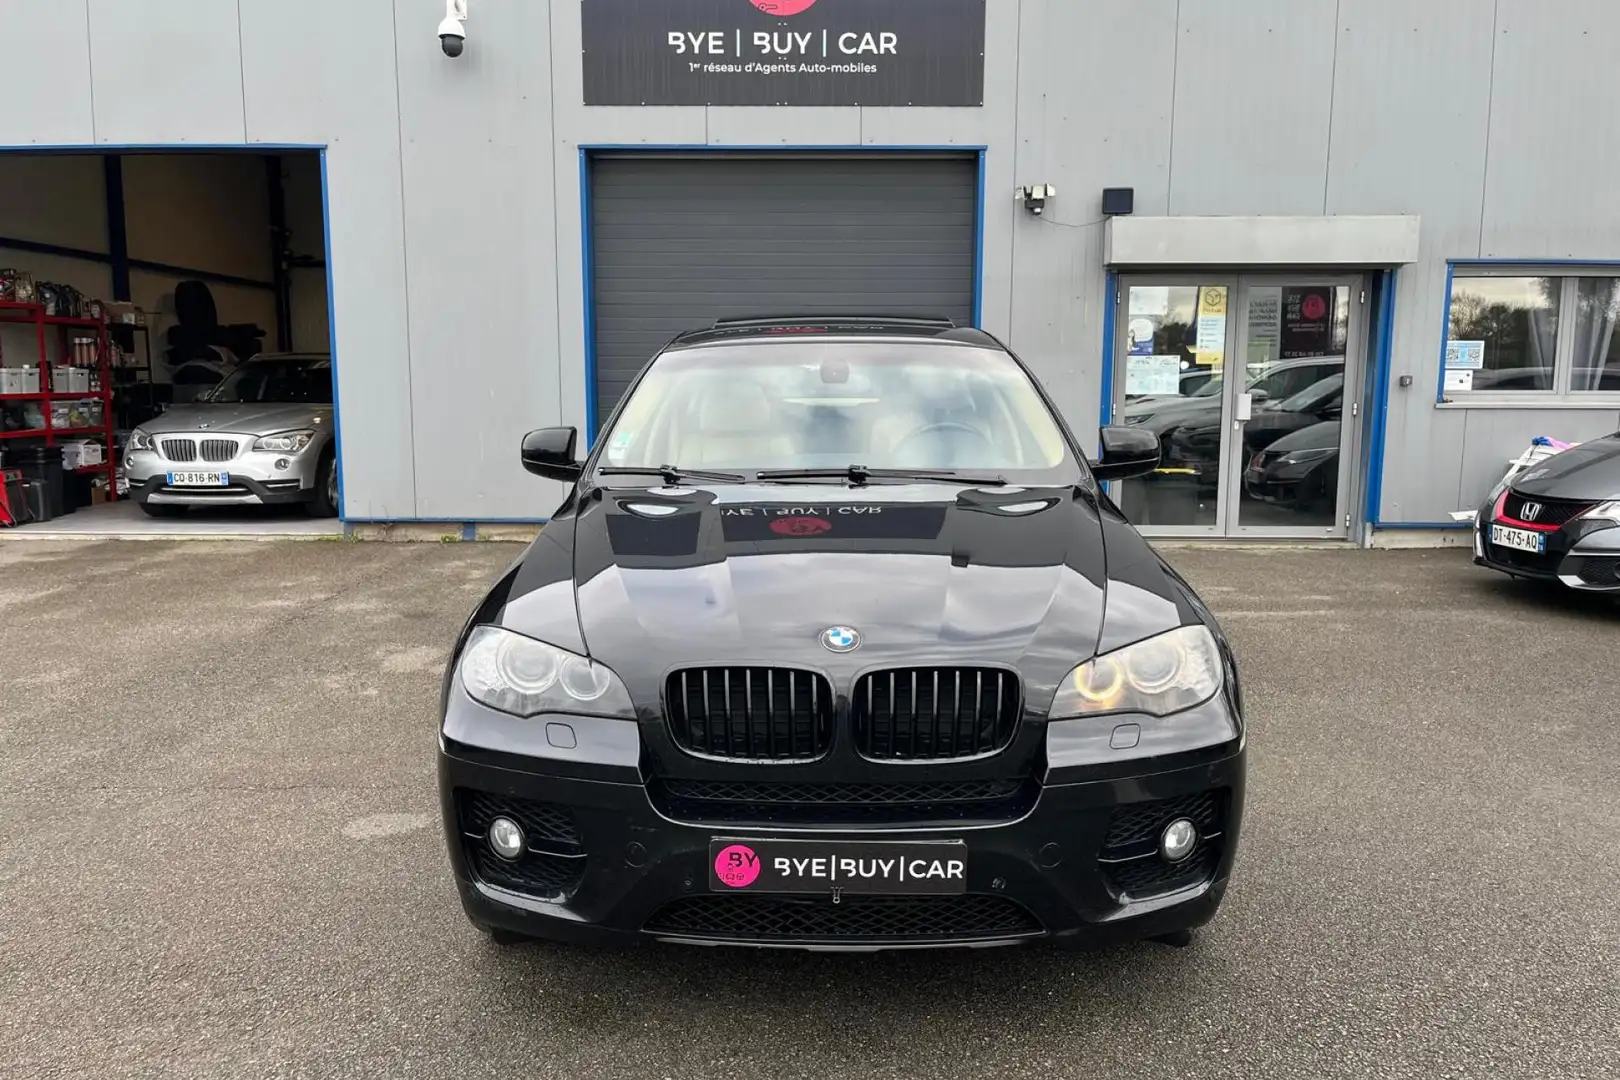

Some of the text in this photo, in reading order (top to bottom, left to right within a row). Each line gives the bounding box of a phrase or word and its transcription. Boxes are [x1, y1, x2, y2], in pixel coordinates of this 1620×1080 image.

[668, 31, 898, 55] BYE BUY CAR
[703, 62, 742, 73] réseau
[744, 62, 796, 75] d'Agents
[798, 62, 877, 73] Auto-mobiles
[1493, 527, 1537, 549] DT-475-AQ
[774, 857, 964, 879] BYE BUY CAR
